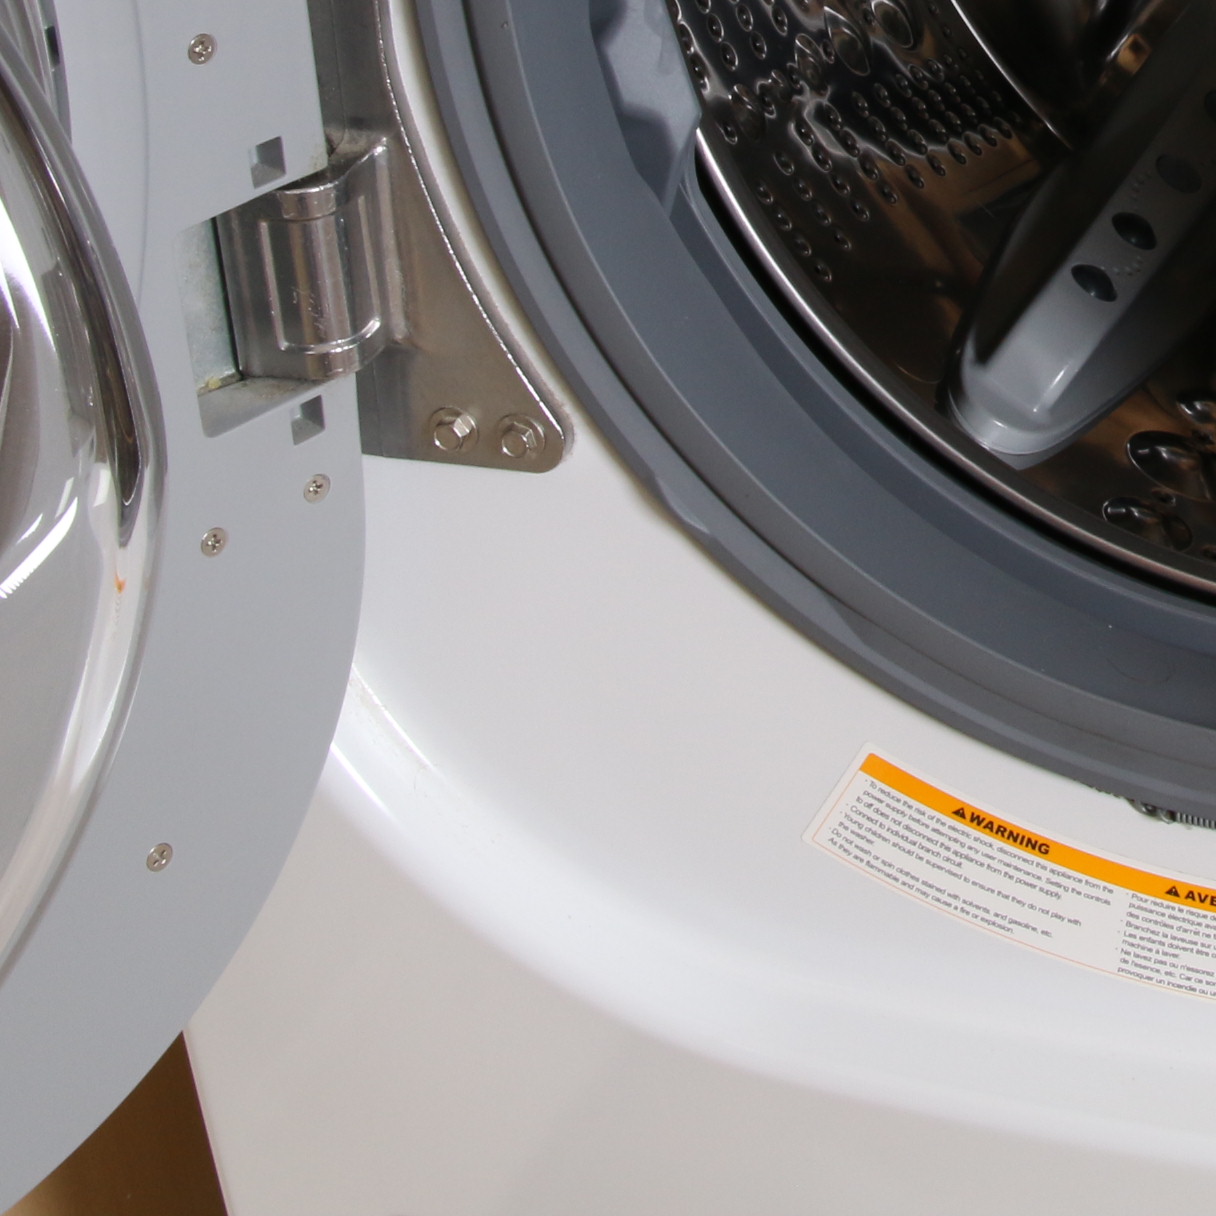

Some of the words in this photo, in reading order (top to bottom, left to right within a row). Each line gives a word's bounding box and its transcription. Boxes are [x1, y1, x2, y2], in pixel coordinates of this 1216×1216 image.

[837, 820, 850, 832] the
[843, 811, 865, 831] Young
[863, 826, 891, 845] children
[890, 840, 916, 857] should
[913, 852, 925, 862] be
[924, 858, 964, 881] supervised
[962, 875, 971, 884] to
[970, 879, 996, 895] ensure
[995, 889, 1011, 901] that
[1010, 895, 1027, 908] they
[1026, 902, 1038, 911] do
[1037, 906, 1051, 916] not
[1049, 911, 1066, 923] play
[1066, 917, 1082, 927] with
[849, 804, 880, 826] Connect
[877, 821, 886, 830] to
[885, 825, 919, 847] individual
[916, 841, 942, 859] branch
[854, 795, 864, 805] to
[862, 801, 875, 810] off
[871, 806, 891, 821] does
[889, 816, 903, 828] not
[901, 823, 940, 847] disconnect
[938, 841, 952, 853] this
[950, 848, 986, 868] appliance
[985, 862, 1003, 876] from
[1002, 870, 1015, 881] the
[1013, 876, 1039, 890] power
[861, 789, 886, 805] power
[884, 801, 908, 819] supply
[907, 813, 931, 830] before
[929, 826, 967, 849] attempting
[965, 844, 981, 855] any
[980, 850, 998, 862] user
[1044, 876, 1070, 893] Setting
[1070, 886, 1083, 896] the
[1082, 892, 1112, 906] controls
[868, 779, 878, 790] To
[876, 786, 902, 804] reduce
[901, 799, 914, 811] the
[913, 806, 927, 818] risk
[926, 813, 937, 822] of
[934, 816, 947, 828] the
[946, 824, 972, 840] electric
[995, 846, 1035, 867] disconnect
[1034, 860, 1048, 872] this
[1048, 867, 1084, 885] appliance
[1083, 878, 1102, 891] from
[1101, 884, 1114, 895] the
[968, 810, 1051, 856] WARNING
[827, 836, 838, 847] As
[837, 842, 853, 857] they
[851, 853, 865, 864] are
[864, 859, 900, 884] flammable
[899, 879, 915, 891] and
[913, 886, 931, 899] may
[930, 894, 953, 908] cause
[958, 905, 971, 917] fire
[970, 912, 980, 920] or
[830, 826, 843, 839] Do
[841, 835, 855, 847] not
[853, 842, 873, 857] wash
[871, 853, 881, 862] or
[879, 858, 896, 870] spin
[894, 866, 921, 883] clothes
[920, 879, 947, 896] stained
[946, 891, 961, 902] with
[992, 911, 1008, 922] and
[1124, 919, 1161, 937] Branchez
[1199, 941, 1213, 950] sur
